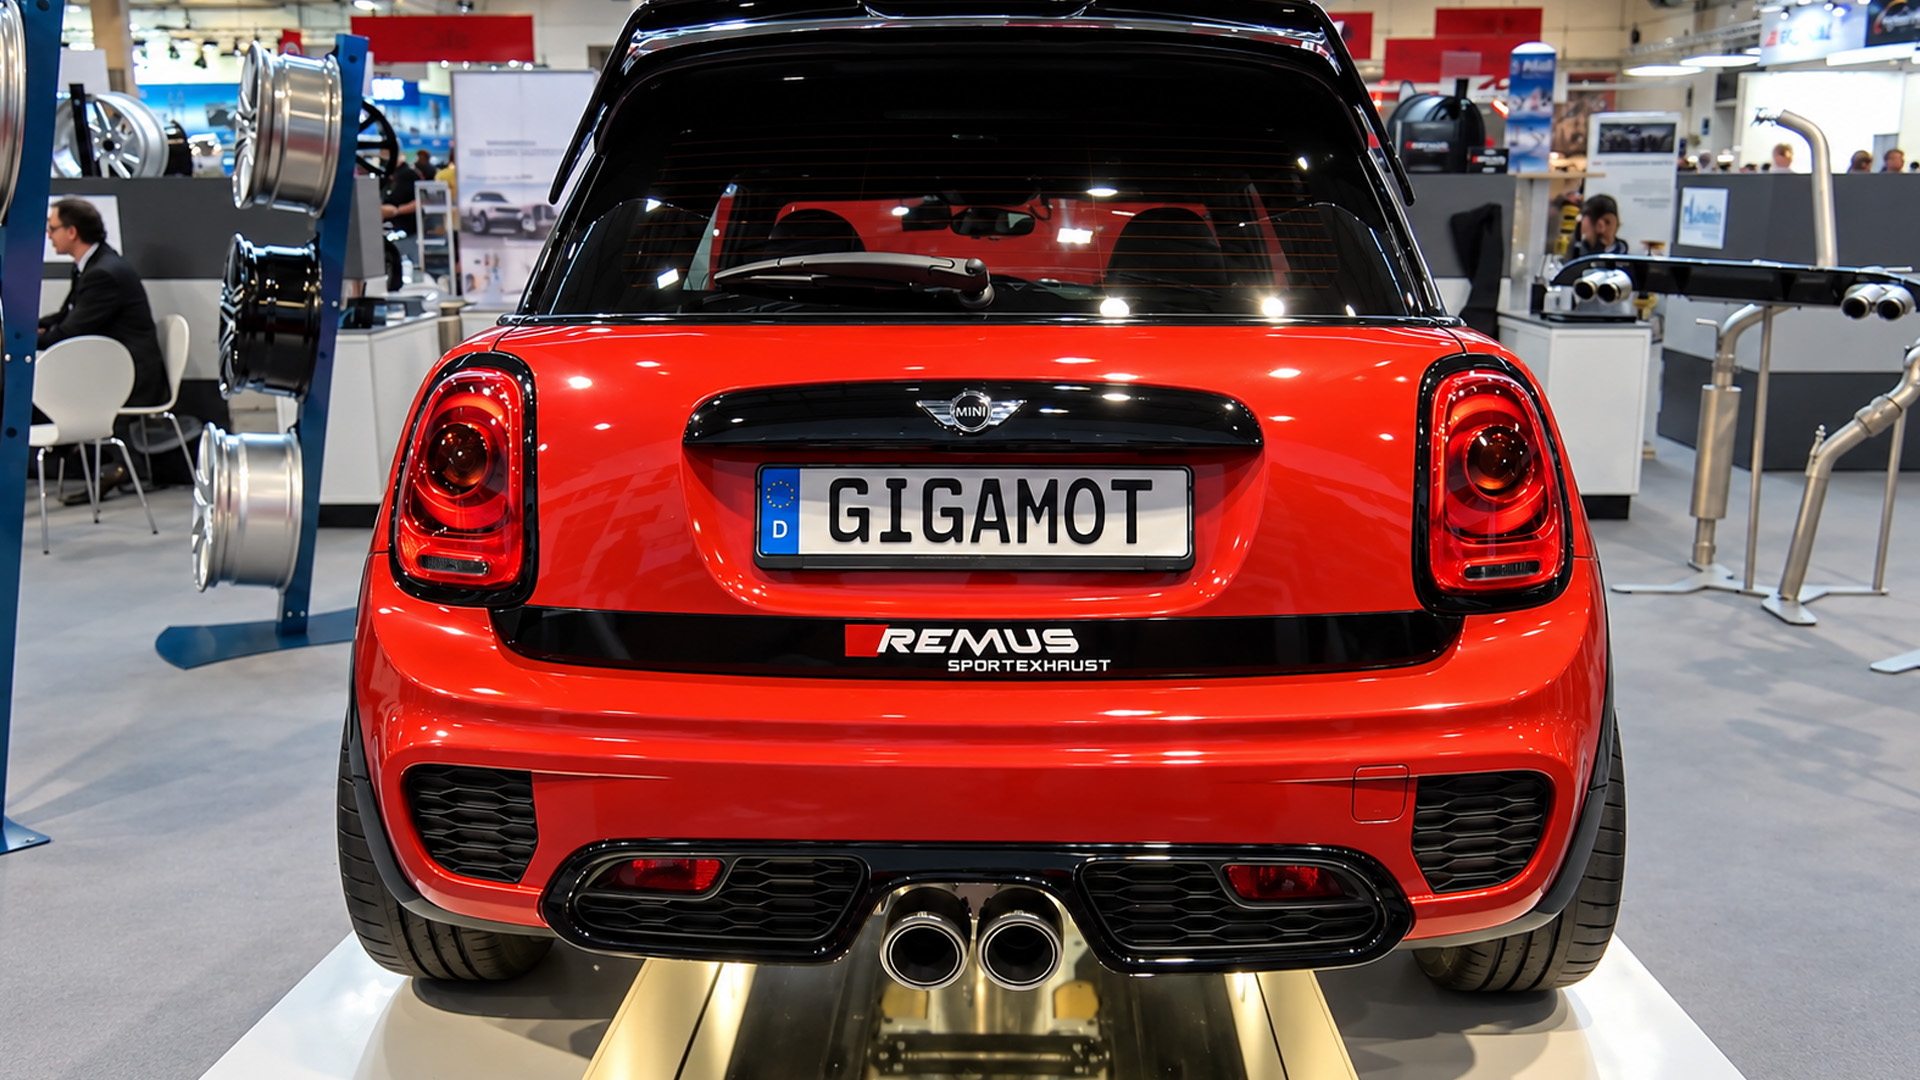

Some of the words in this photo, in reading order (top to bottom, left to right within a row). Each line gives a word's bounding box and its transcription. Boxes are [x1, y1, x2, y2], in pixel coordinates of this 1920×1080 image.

[955, 406, 987, 418] MINI
[828, 477, 1153, 545] GIGAMOT
[772, 520, 788, 539] D
[876, 628, 1080, 657] REMUS
[947, 659, 1112, 673] SPORTEXHAUST
